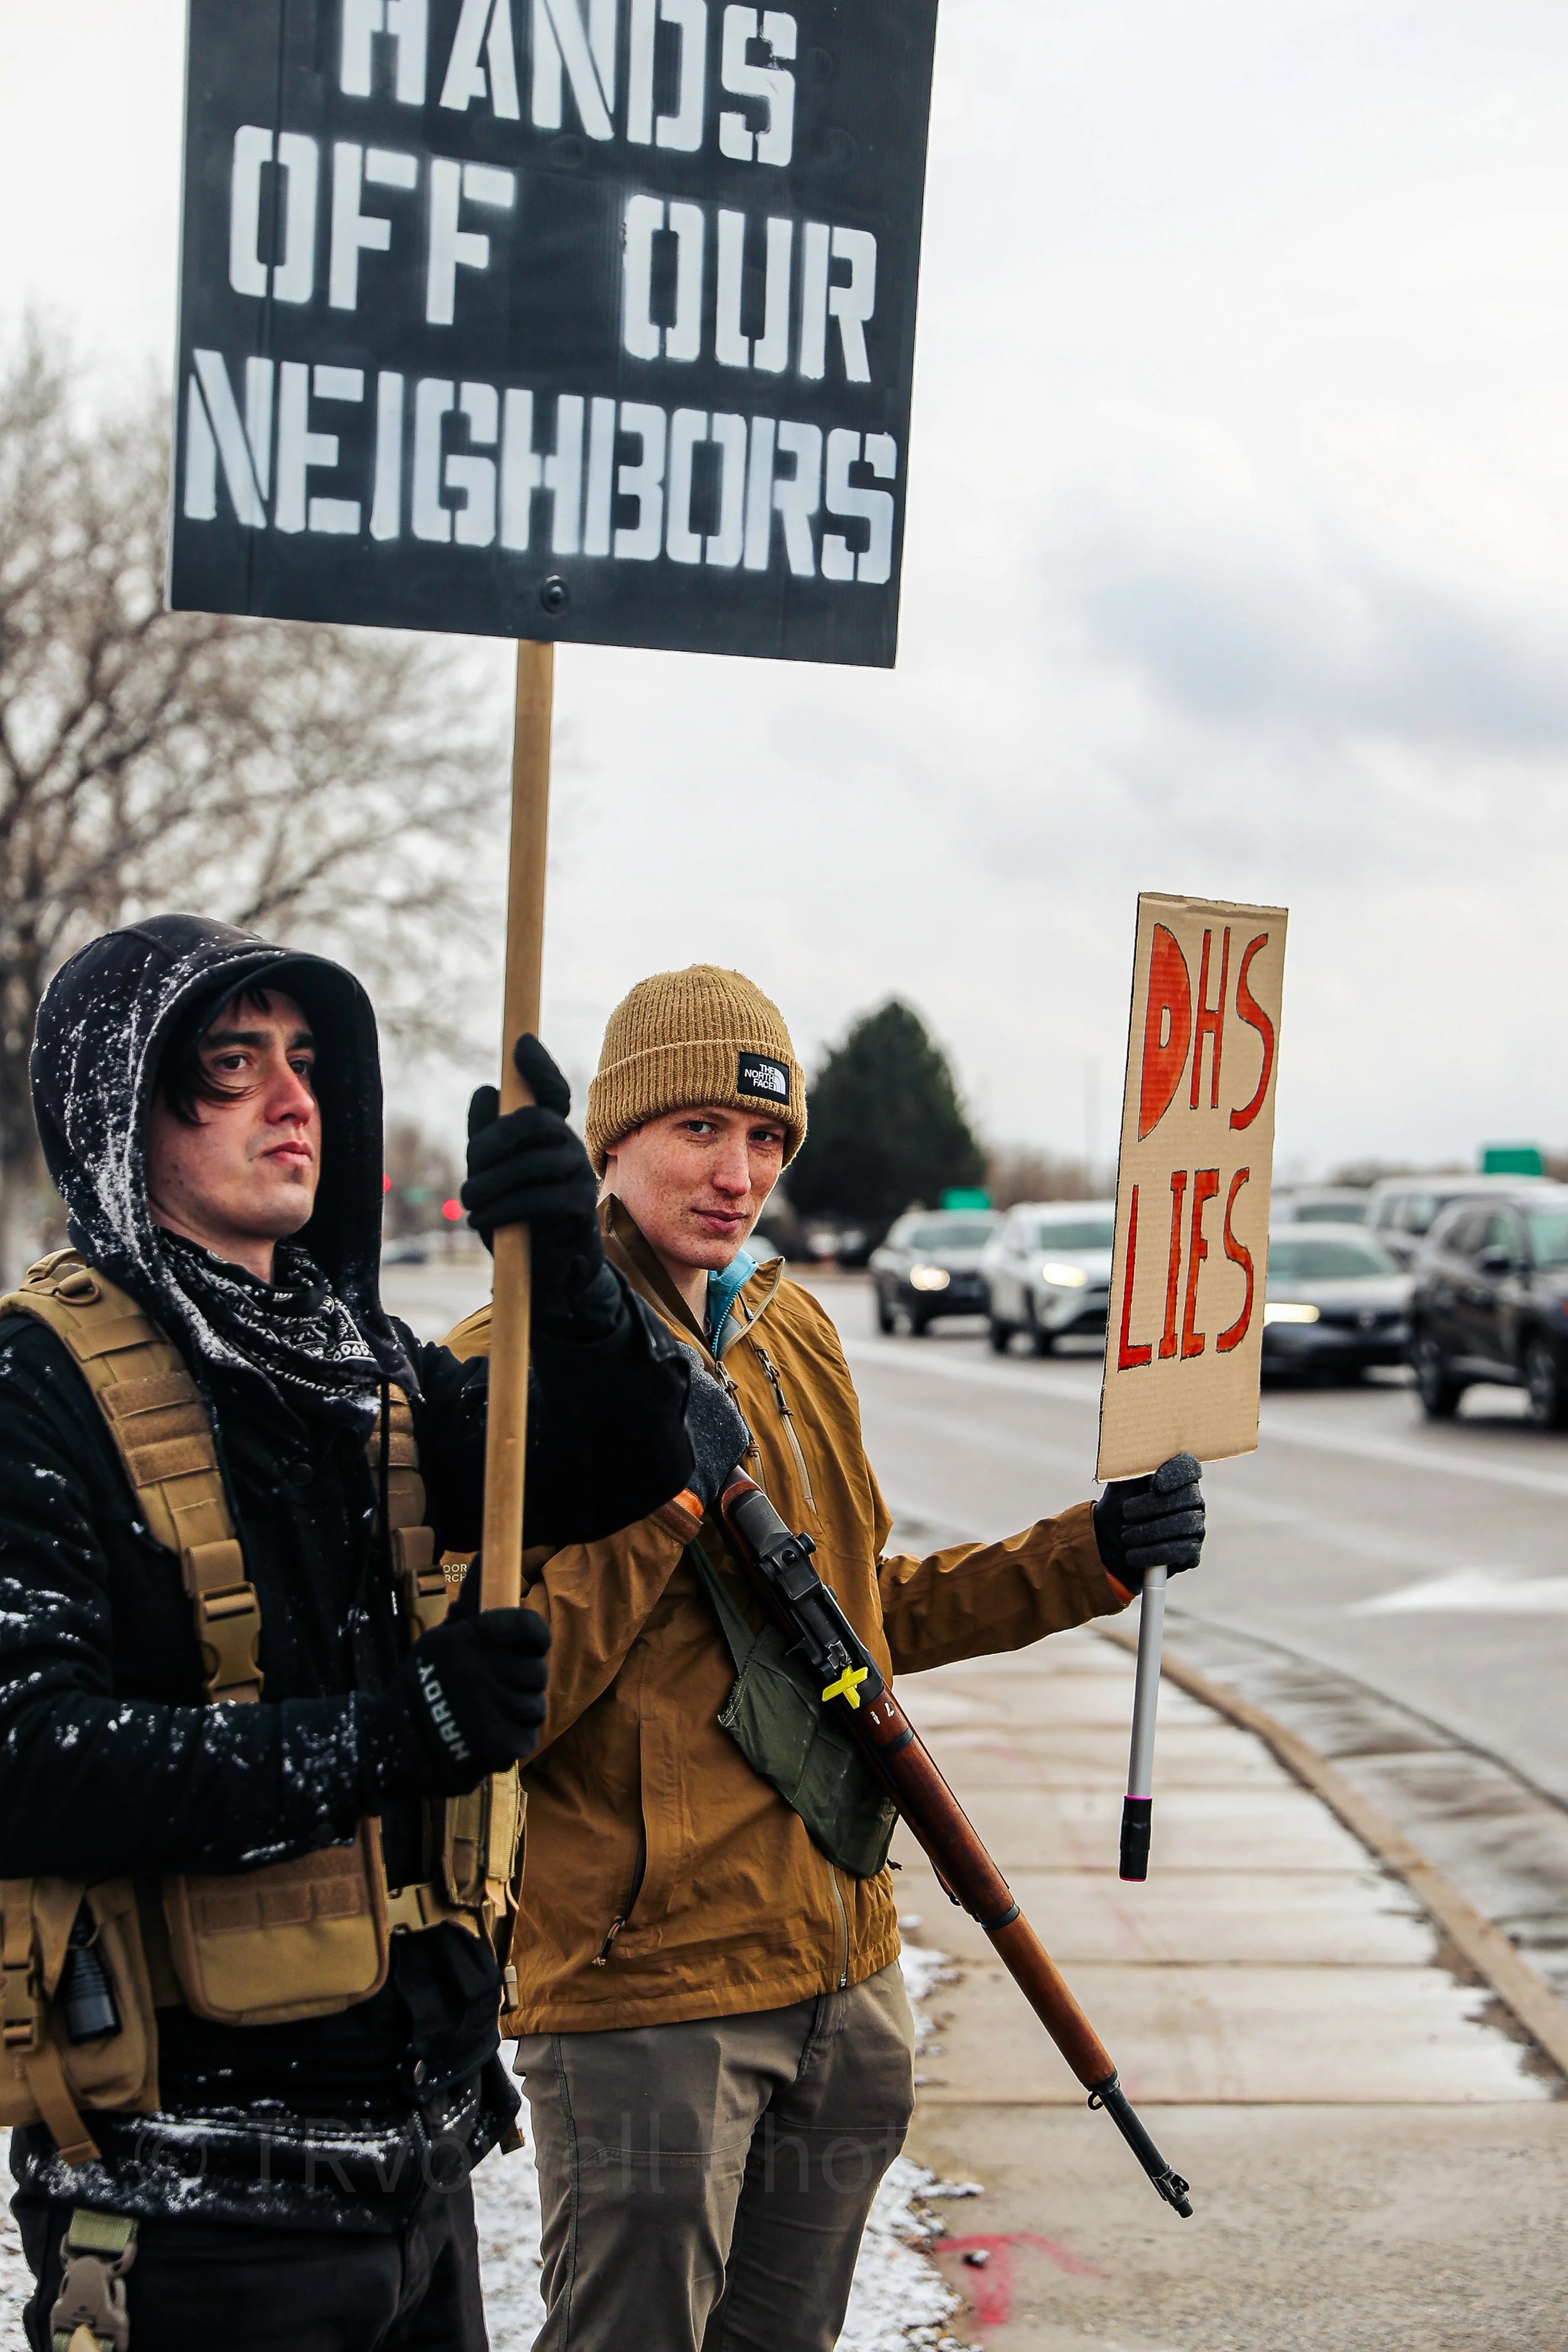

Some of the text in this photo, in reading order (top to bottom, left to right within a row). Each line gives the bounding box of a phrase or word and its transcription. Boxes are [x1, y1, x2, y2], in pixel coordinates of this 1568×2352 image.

[339, 0, 798, 167] HANDS
[229, 125, 878, 383] OFF OUR
[184, 348, 898, 585] NEIGHBORS
[744, 1068, 775, 1083] NORTH
[753, 1078, 775, 1091] FACE
[760, 1063, 775, 1075] THE
[1138, 922, 1275, 1143] DHS
[1118, 1167, 1254, 1372] LIES
[417, 1663, 472, 1762] HARDY
